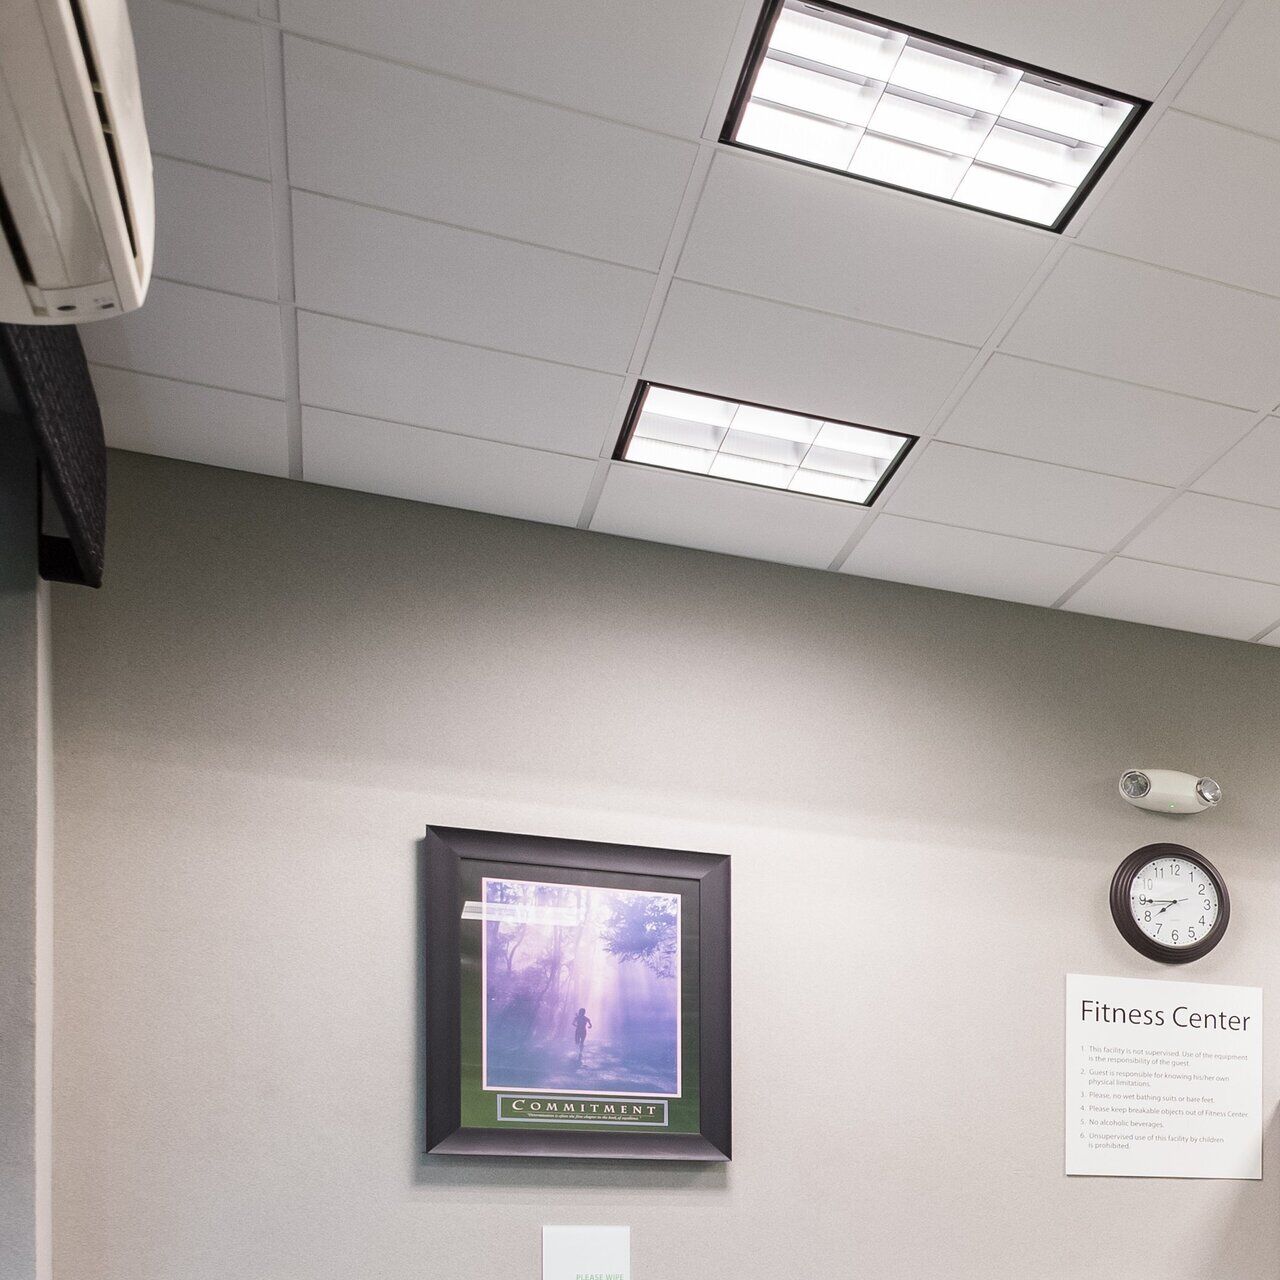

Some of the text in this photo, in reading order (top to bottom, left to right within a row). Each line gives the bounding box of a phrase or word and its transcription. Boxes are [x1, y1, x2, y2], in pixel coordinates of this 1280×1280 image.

[1155, 867, 1164, 878] 11
[1170, 864, 1181, 876] 12
[1189, 871, 1193, 882] 1
[1142, 878, 1153, 890] 10
[1198, 884, 1205, 895] 2
[1203, 899, 1211, 910] 3
[1144, 911, 1151, 922] 8
[1198, 915, 1205, 926] 4
[1156, 923, 1162, 934] 7
[1188, 927, 1195, 938] 5
[1172, 930, 1179, 941] 6
[1082, 1000, 1250, 1031] Fitness Center
[1089, 1045, 1102, 1053] This
[1103, 1046, 1126, 1055] facility
[1107, 1057, 1151, 1065] responsibility
[1089, 1068, 1108, 1076] Guest
[1164, 1072, 1192, 1081] knowing
[1089, 1078, 1115, 1087] physical
[1136, 1094, 1161, 1102] bathing
[512, 1100, 656, 1115] COMMITMENT
[1128, 1106, 1160, 1114] breakable
[1167, 1135, 1189, 1143] facility
